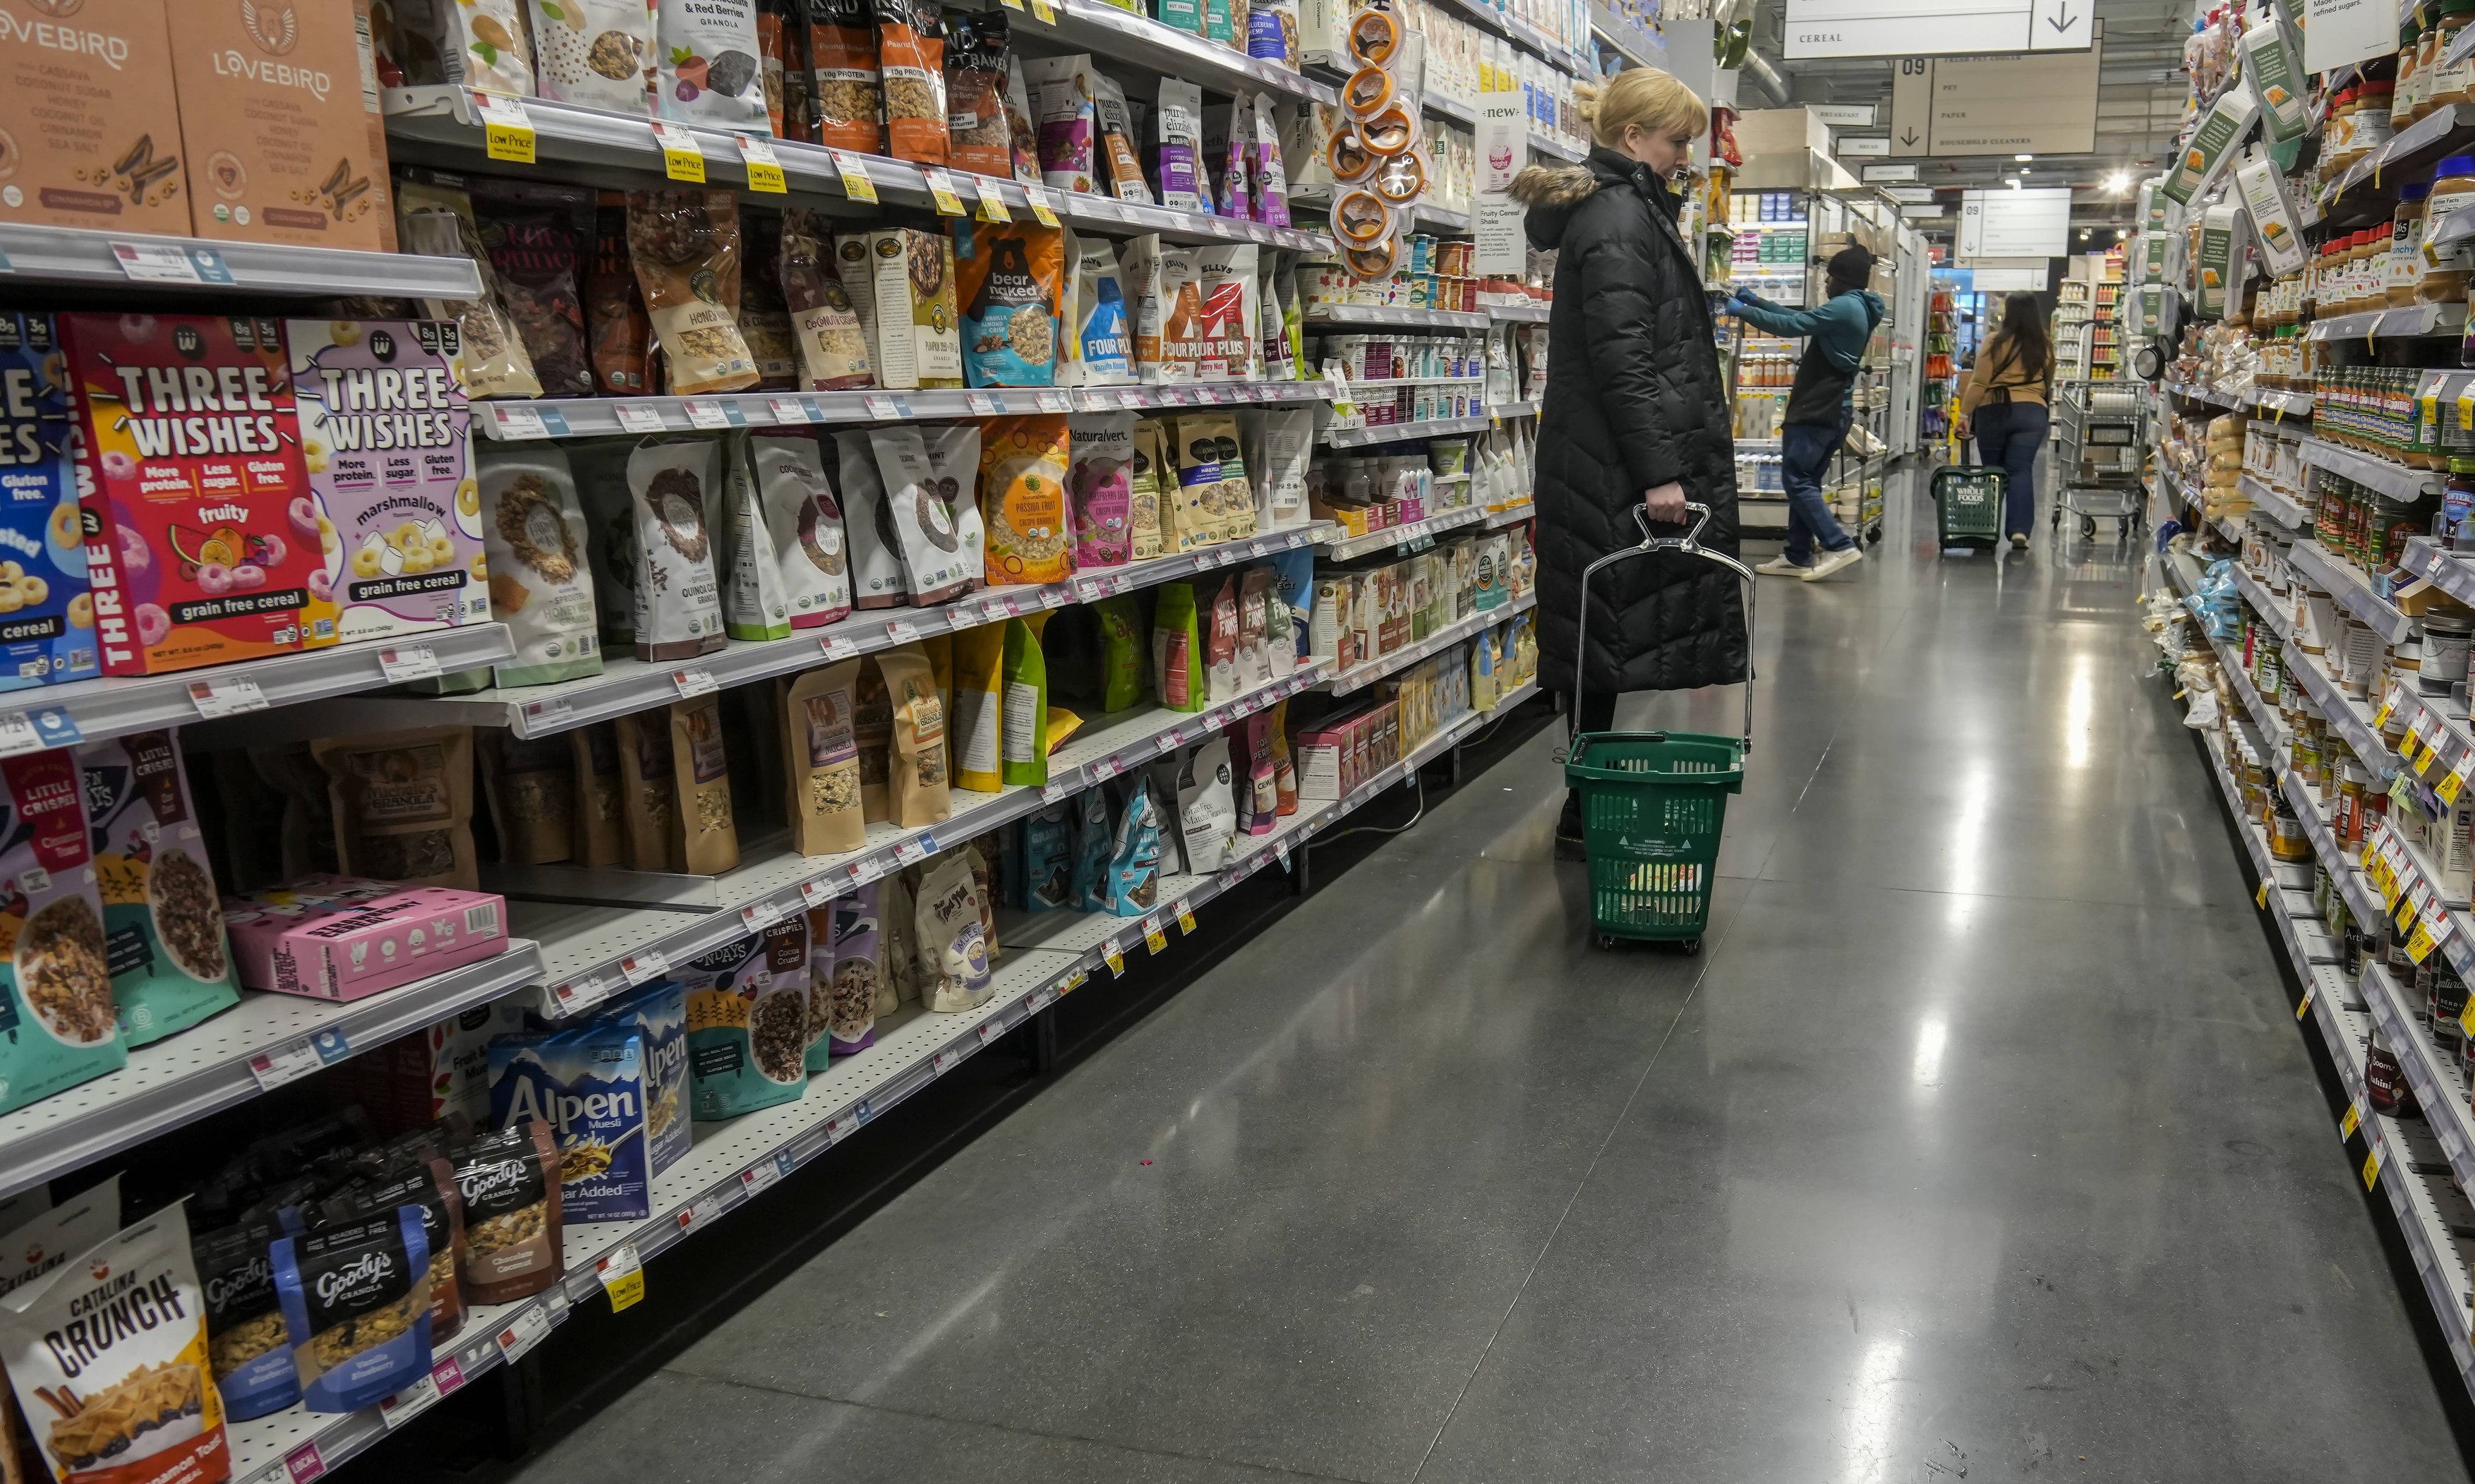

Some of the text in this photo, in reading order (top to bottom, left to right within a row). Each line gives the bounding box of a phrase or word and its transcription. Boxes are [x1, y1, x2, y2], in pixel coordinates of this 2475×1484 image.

[685, 4, 745, 19] & Red Berries
[2313, 1, 2363, 18] refined sugars.
[700, 18, 740, 30] GRANOLA
[1799, 33, 1843, 44] CEREAL
[1902, 58, 1926, 76] 09
[824, 71, 866, 80] 10g PROTEIN
[1486, 107, 1517, 118] new
[490, 133, 532, 149] Low Price
[1939, 138, 1988, 147] HOUSEHOLD
[668, 155, 702, 170] Low Price
[1491, 159, 1508, 168] night
[749, 169, 783, 182] Low Price
[1965, 205, 1980, 215] 09
[992, 272, 1029, 286] bear
[989, 284, 1038, 297] naked
[689, 311, 717, 325] HONEY
[29, 320, 47, 334] 3g
[234, 321, 251, 336] 8g
[260, 322, 276, 337] 3g
[421, 327, 435, 340] 8g
[444, 327, 456, 340] 3g
[1088, 338, 1118, 356] FOUR
[1217, 340, 1245, 356] PLUS
[1093, 361, 1112, 373] Vanilla
[1211, 362, 1224, 371] Nut
[116, 366, 274, 414] THREE
[320, 368, 450, 411] THREE
[127, 415, 279, 457] WISHES
[326, 412, 452, 451] WISHES
[1068, 428, 1127, 443] Naturalvert
[247, 461, 286, 473] Gluten
[338, 459, 366, 470] More
[387, 457, 411, 467] Less
[425, 455, 455, 464] Gluten
[145, 466, 180, 478] More
[203, 464, 232, 476] Less
[333, 469, 376, 483] protein.
[385, 469, 416, 479] sugar.
[431, 465, 453, 475] free.
[1, 474, 49, 488] Gluten
[140, 478, 193, 494] protein.
[203, 476, 240, 490] sugar.
[257, 473, 284, 485] free.
[11, 488, 45, 501] free.
[1956, 485, 1985, 495] WHOLE
[198, 502, 249, 524] fruity
[356, 495, 447, 526] marshmallow
[1016, 500, 1056, 513] PASSION FRUIT
[1018, 517, 1056, 528] CRISPY GRANOLA
[359, 573, 459, 599] grain free cereal
[682, 585, 706, 598] QUINOA
[85, 543, 133, 668] THREE
[554, 592, 585, 605] SPROUTED
[181, 591, 301, 622] grain free cereal
[2, 618, 55, 639] cereal
[920, 711, 943, 727] GRANOLA
[825, 740, 853, 756] MUESLI
[25, 780, 72, 802] LITTLE
[372, 794, 435, 809] GRANOLA
[1184, 807, 1228, 828] Matcha Granola
[306, 900, 423, 936] STRAWBERRY
[766, 923, 804, 938] CRISPIES
[956, 927, 983, 951] MUESL
[778, 947, 800, 958] Cocoa
[502, 1074, 637, 1134] Alpen
[588, 1118, 622, 1130] Muesli
[461, 1159, 529, 1207] Goody's
[579, 1183, 623, 1198] Added
[481, 1186, 520, 1202] GRANOLA
[316, 1250, 394, 1309] Goody's
[70, 1269, 138, 1317] CATALINA
[339, 1283, 384, 1302] GRANOLA
[44, 1272, 187, 1379] CRUNCH
[435, 1367, 457, 1384] LOCAL
[291, 1452, 319, 1477] LOCAL
